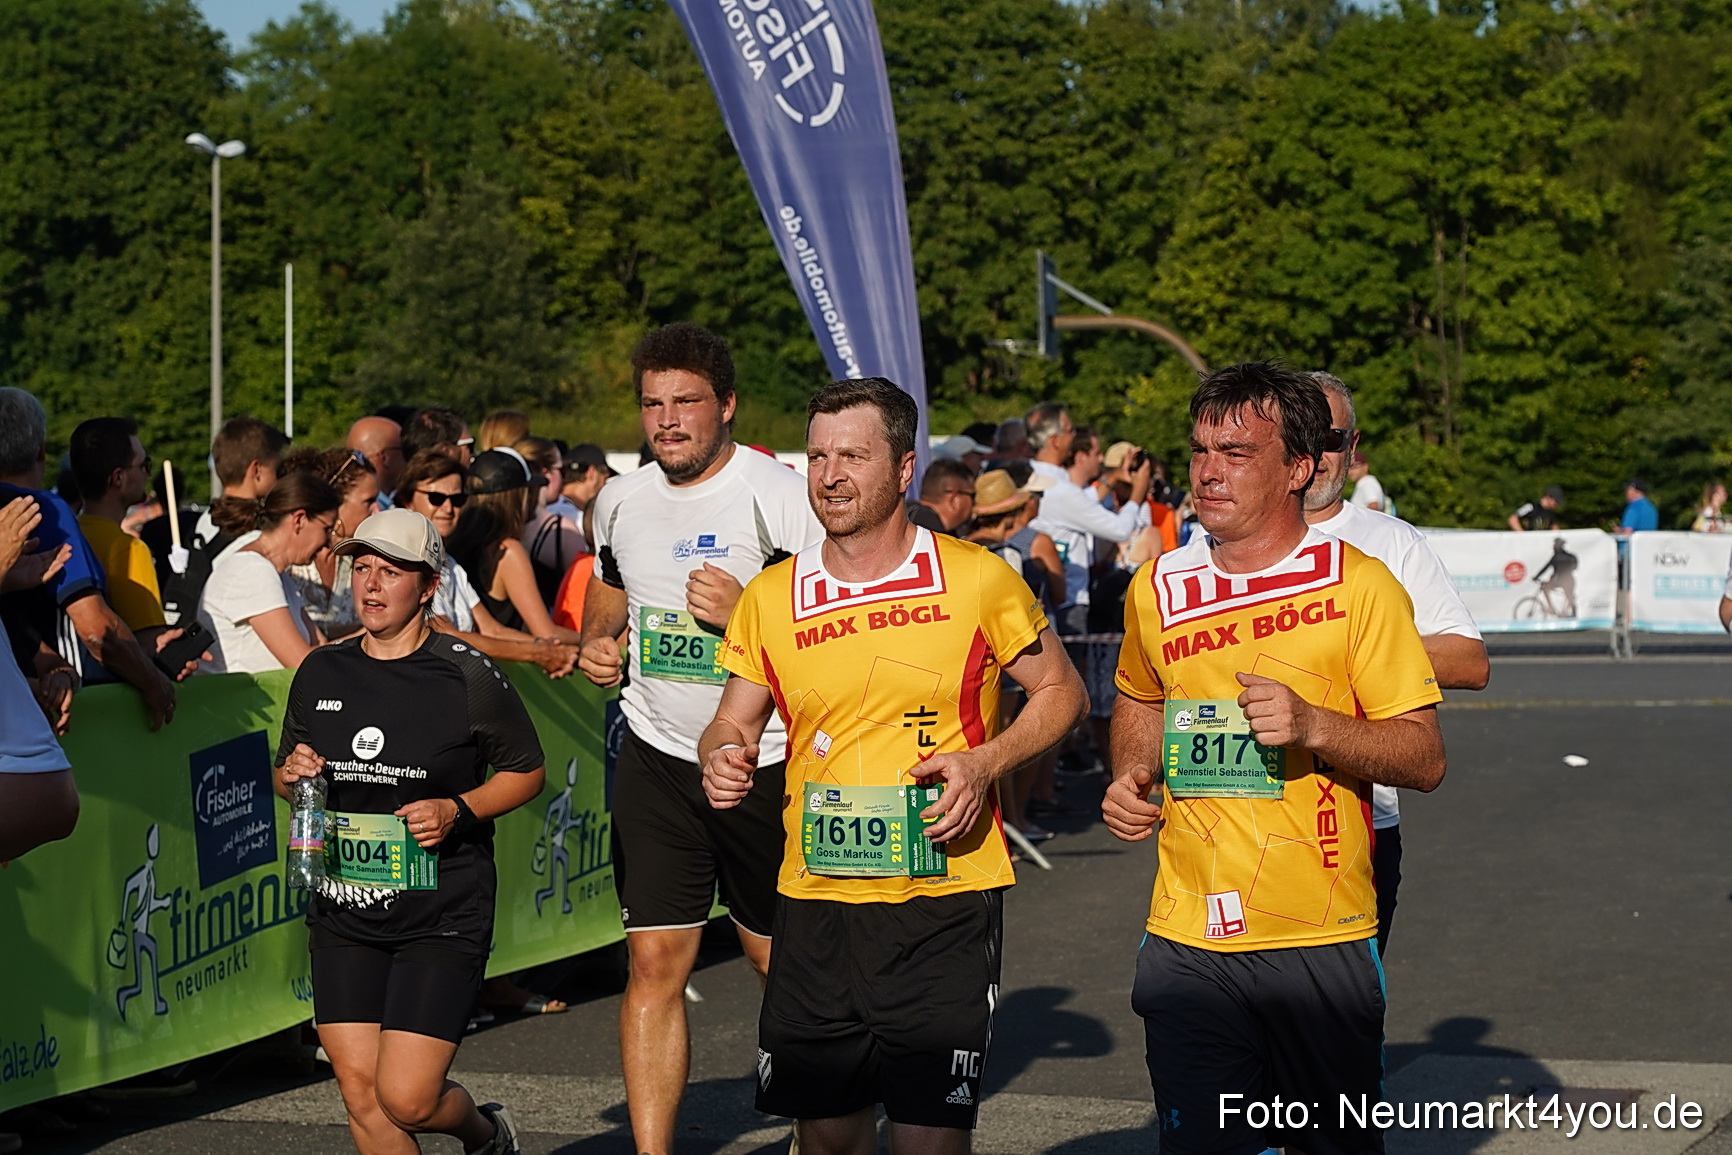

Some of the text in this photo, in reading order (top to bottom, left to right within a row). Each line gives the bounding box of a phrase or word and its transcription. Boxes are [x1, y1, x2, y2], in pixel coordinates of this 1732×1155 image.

[794, 603, 951, 651] MAX BÖGL
[1161, 597, 1346, 667] MAX BÖGL
[643, 638, 651, 663] RUN
[658, 633, 704, 659] 526
[650, 656, 713, 671] Wein Sebastian
[316, 699, 343, 711] JAKO
[1168, 744, 1180, 777] RUN
[1190, 733, 1252, 765] 817
[333, 772, 398, 786] SCHOTTERWERKE
[1177, 767, 1266, 778] Nennstiel Sebastian
[1266, 746, 1278, 785] 202
[206, 780, 257, 816] Fischer
[212, 803, 253, 827] AUTOMOBILE
[814, 815, 887, 847] 1619
[580, 810, 613, 872] fir
[804, 823, 813, 855] RUN
[816, 847, 883, 860] Goss Markus
[890, 822, 903, 863] 2022
[356, 865, 392, 874] Samantha
[391, 844, 402, 880] 2022
[176, 943, 249, 1002] neumarkt
[951, 1049, 981, 1078] MG
[946, 1095, 974, 1106] adidas
